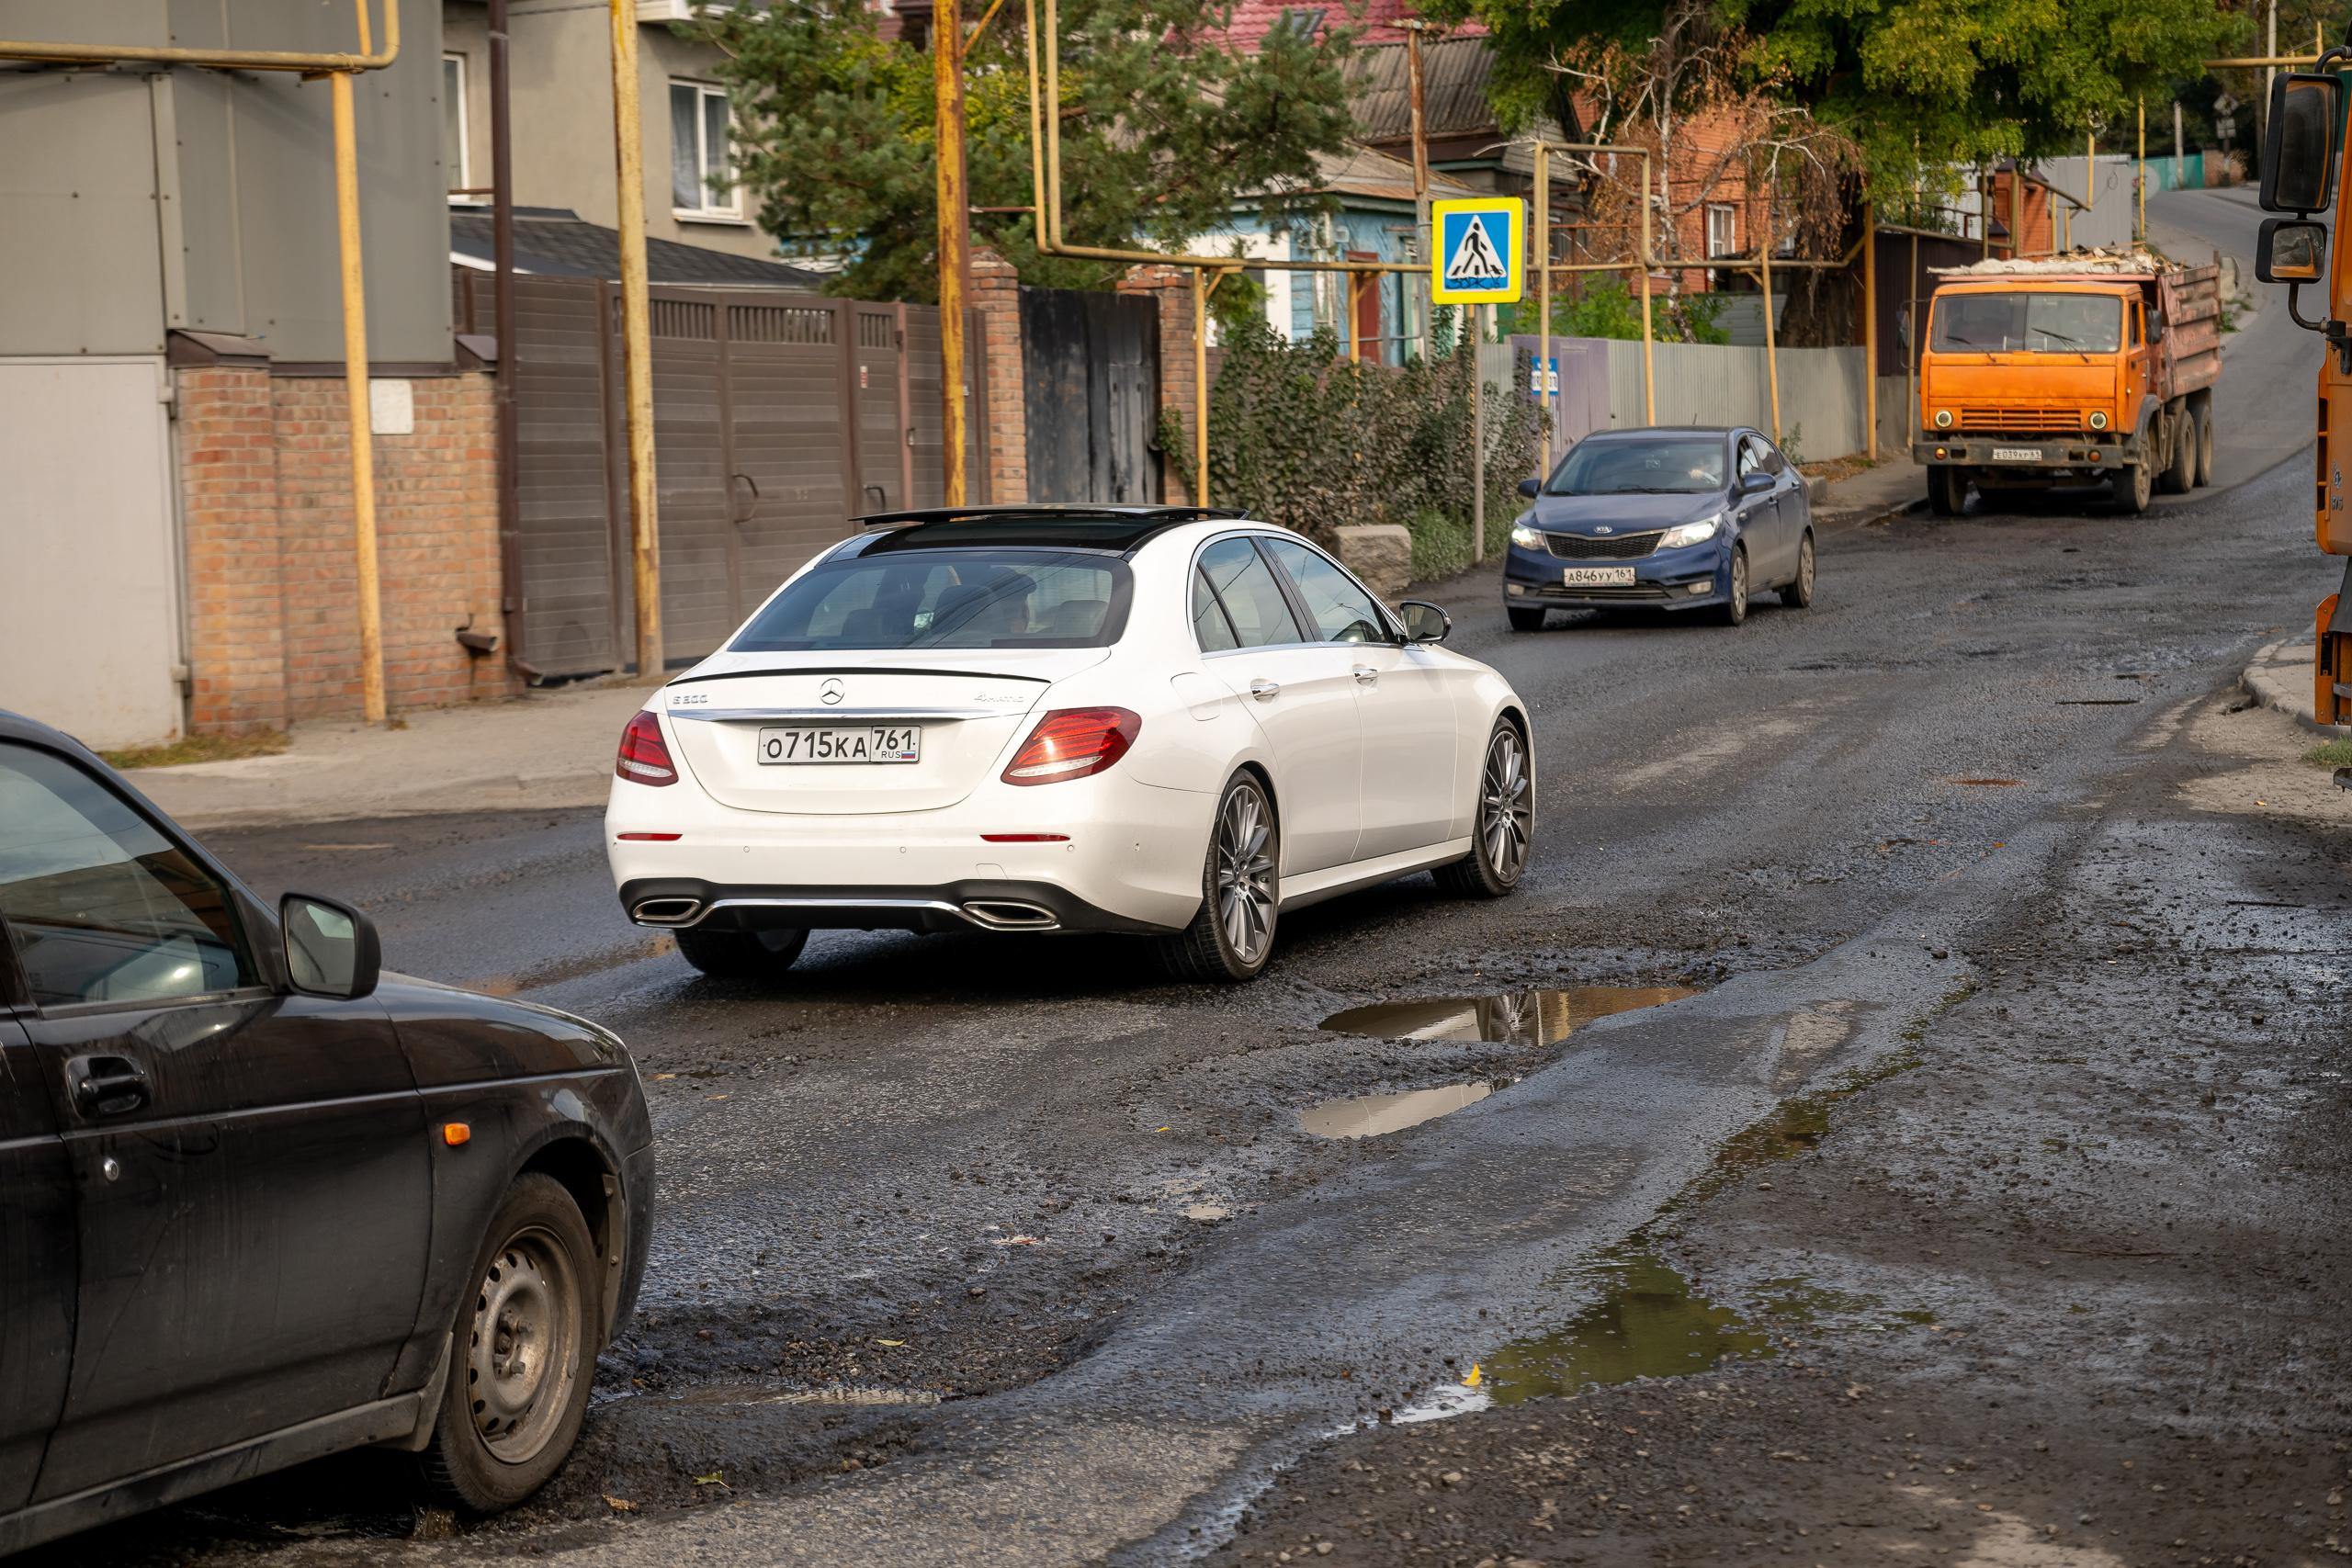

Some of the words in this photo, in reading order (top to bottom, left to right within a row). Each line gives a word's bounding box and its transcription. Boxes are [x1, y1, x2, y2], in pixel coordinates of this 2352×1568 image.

[1615, 569, 1632, 579] 161
[874, 729, 912, 750] 761
[881, 750, 901, 759] RUS
